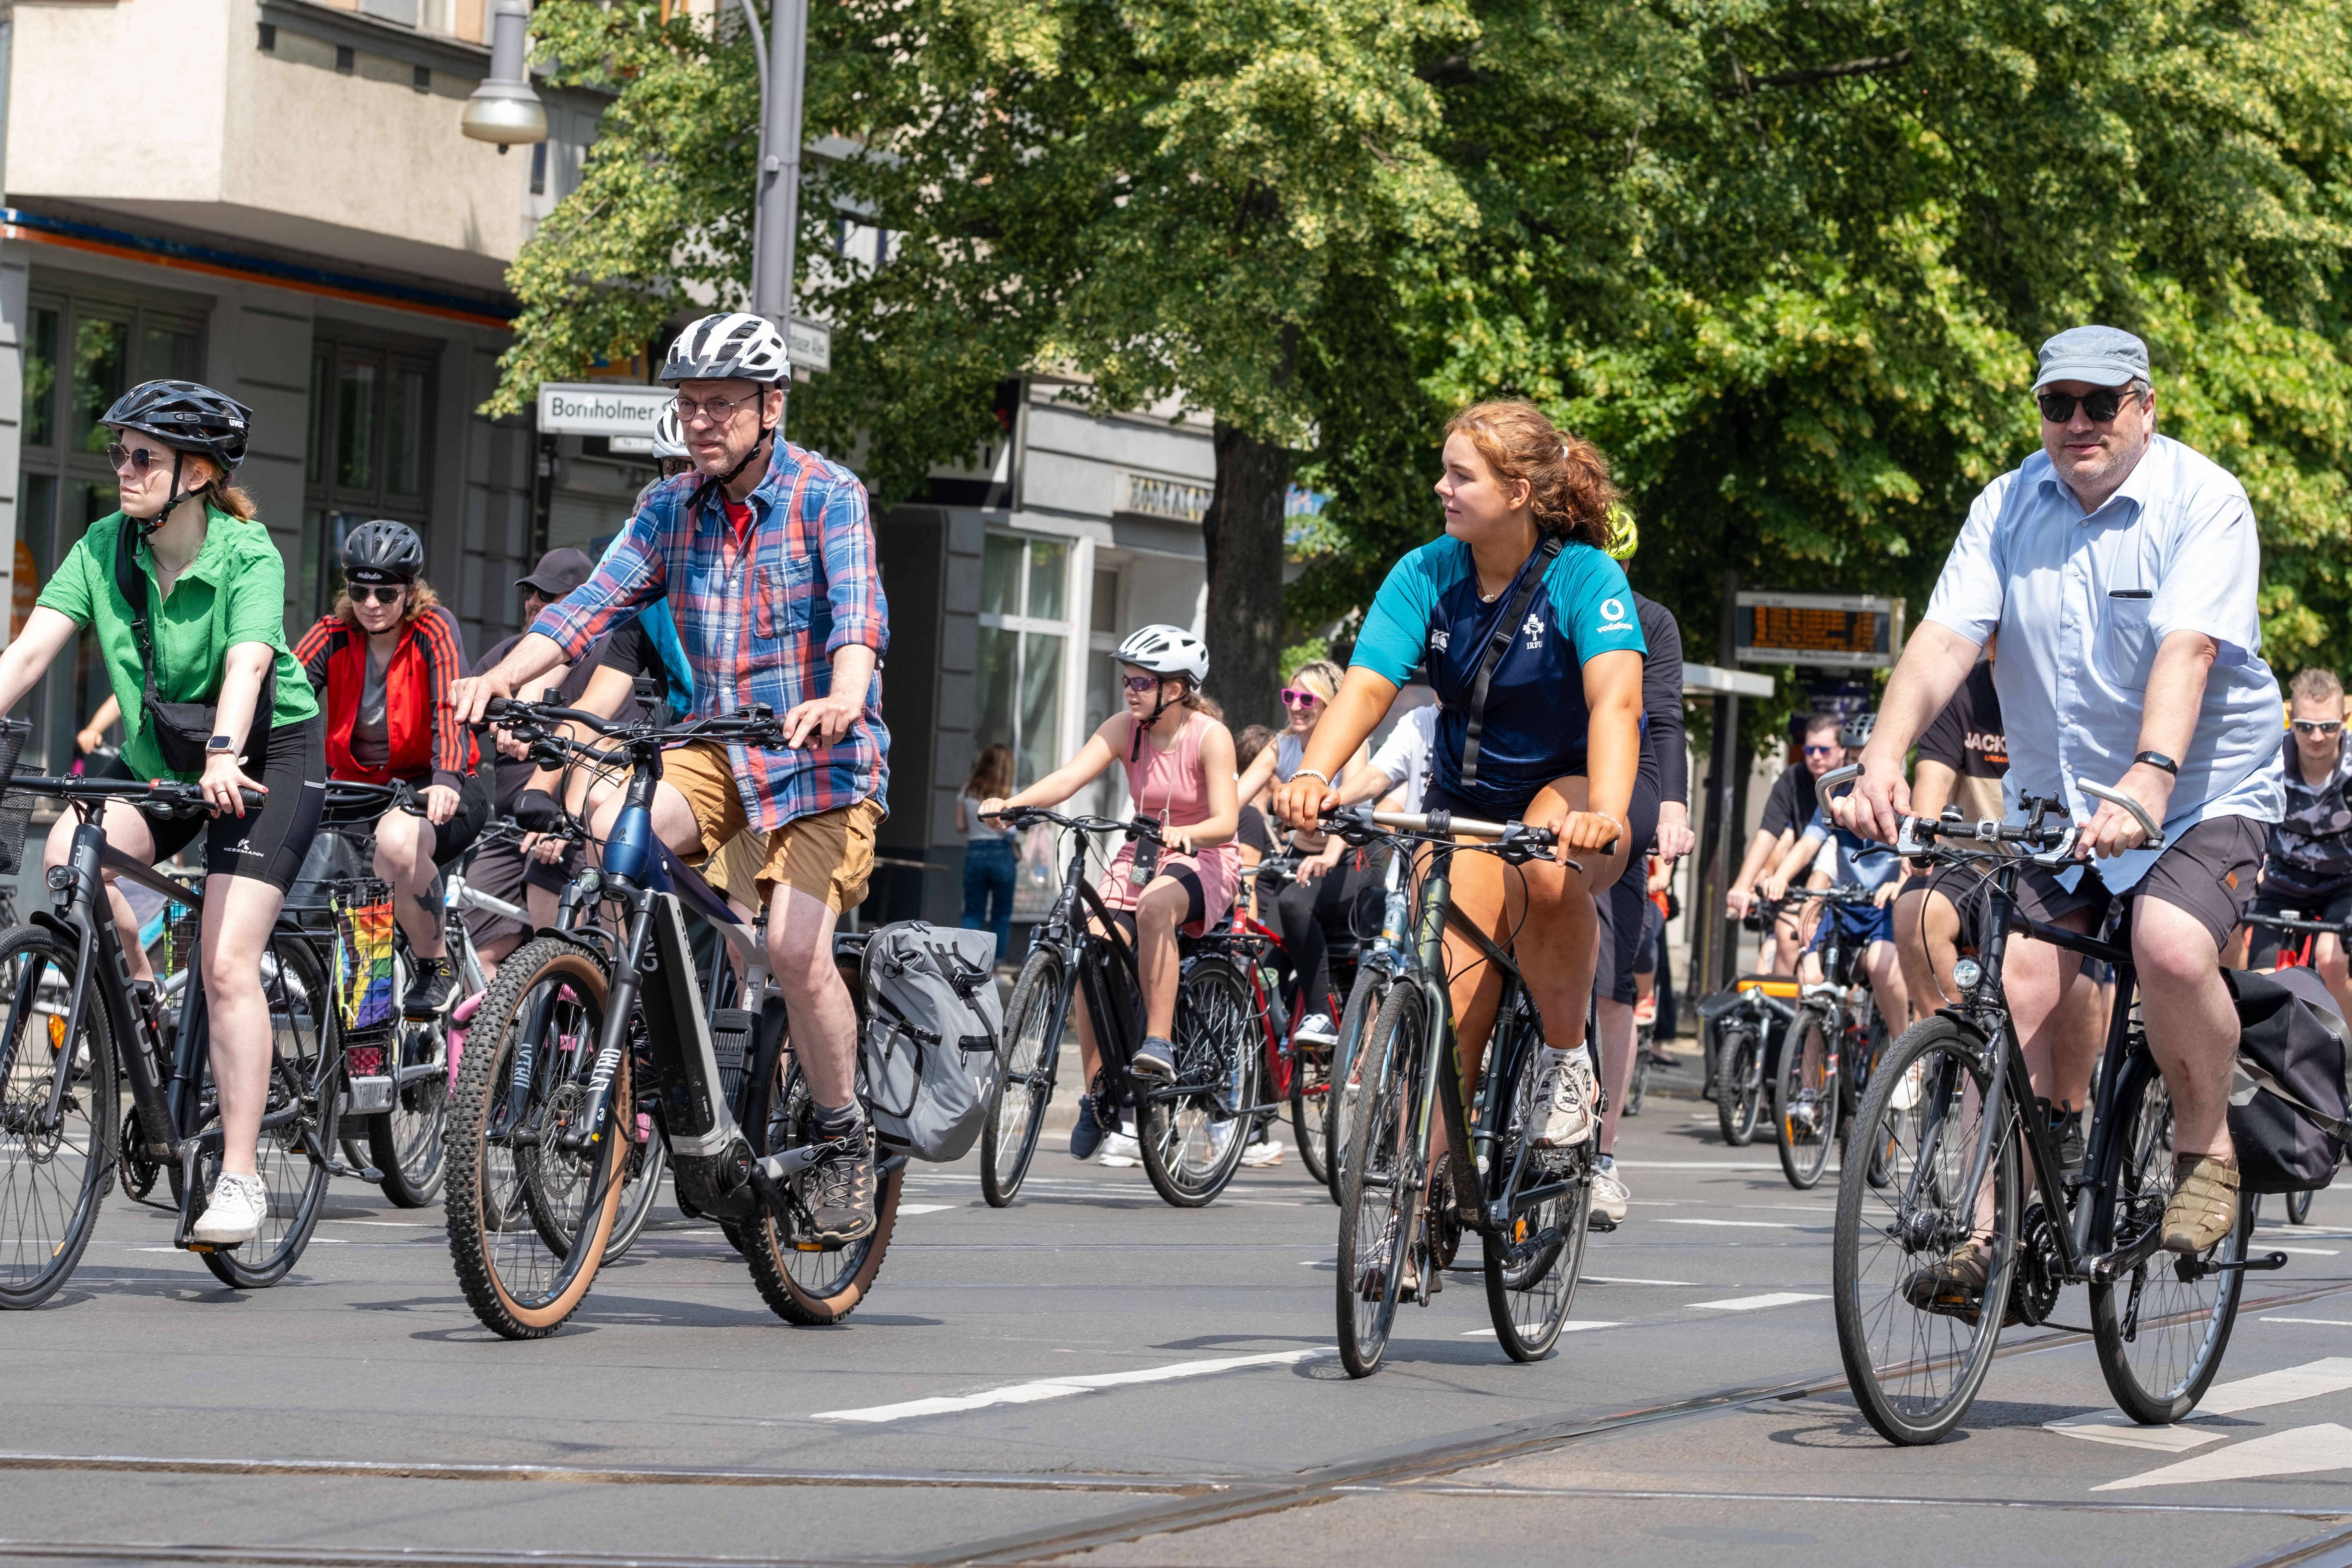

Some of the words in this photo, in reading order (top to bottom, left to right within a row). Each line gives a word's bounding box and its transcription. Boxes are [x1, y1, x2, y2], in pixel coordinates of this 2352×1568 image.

[552, 397, 655, 421] Bornholmer
[229, 419, 244, 428] uvex
[1597, 621, 1633, 633] vodafone
[1526, 641, 1543, 650] IRFU
[223, 847, 264, 857] KOSSMANN
